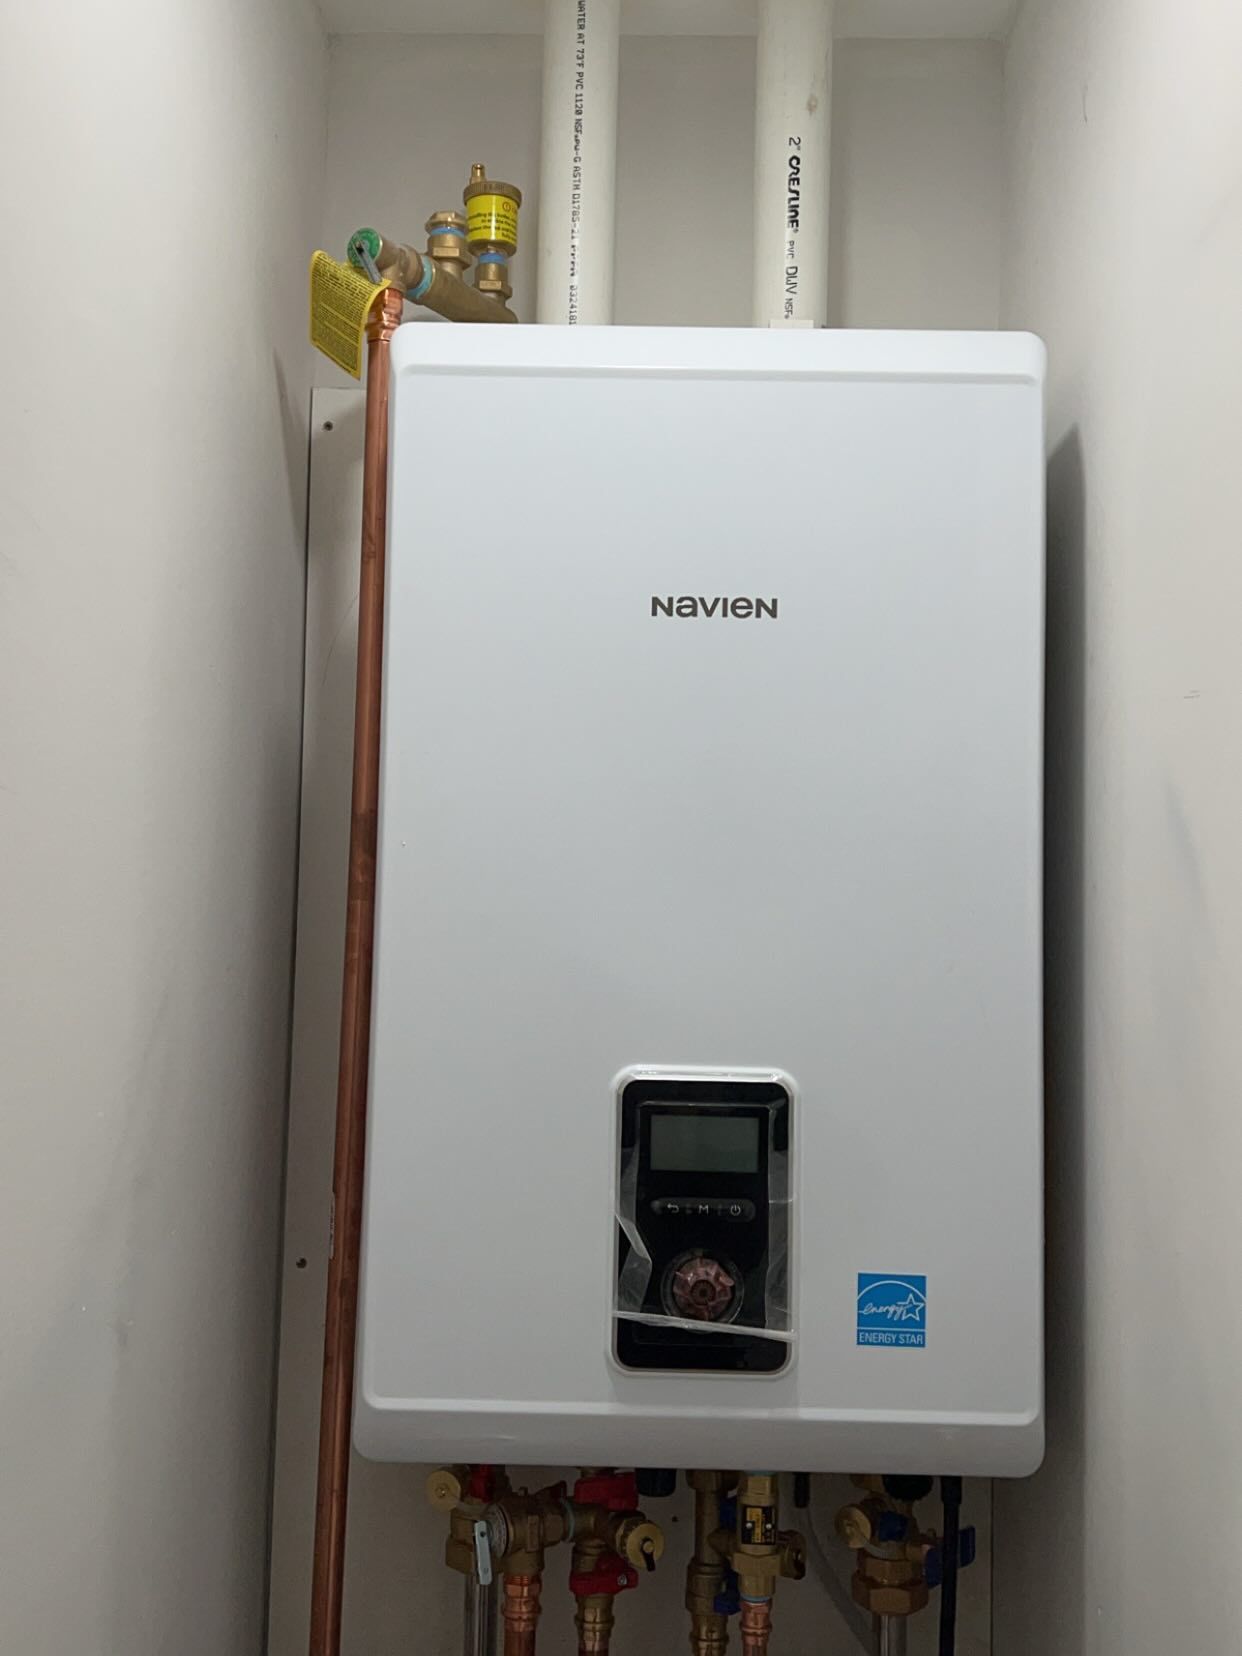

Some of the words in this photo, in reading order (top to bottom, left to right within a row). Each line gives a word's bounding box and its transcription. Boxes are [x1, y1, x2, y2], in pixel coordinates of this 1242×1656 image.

[576, 33, 585, 45] AT
[575, 71, 584, 90] PVC
[574, 93, 584, 115] 1120
[572, 165, 582, 191] ASTM
[786, 240, 795, 260] PVC
[785, 266, 798, 294] DWV
[698, 1204, 709, 1214] M
[859, 1332, 897, 1344] ENERGY
[898, 1333, 923, 1345] STAR
